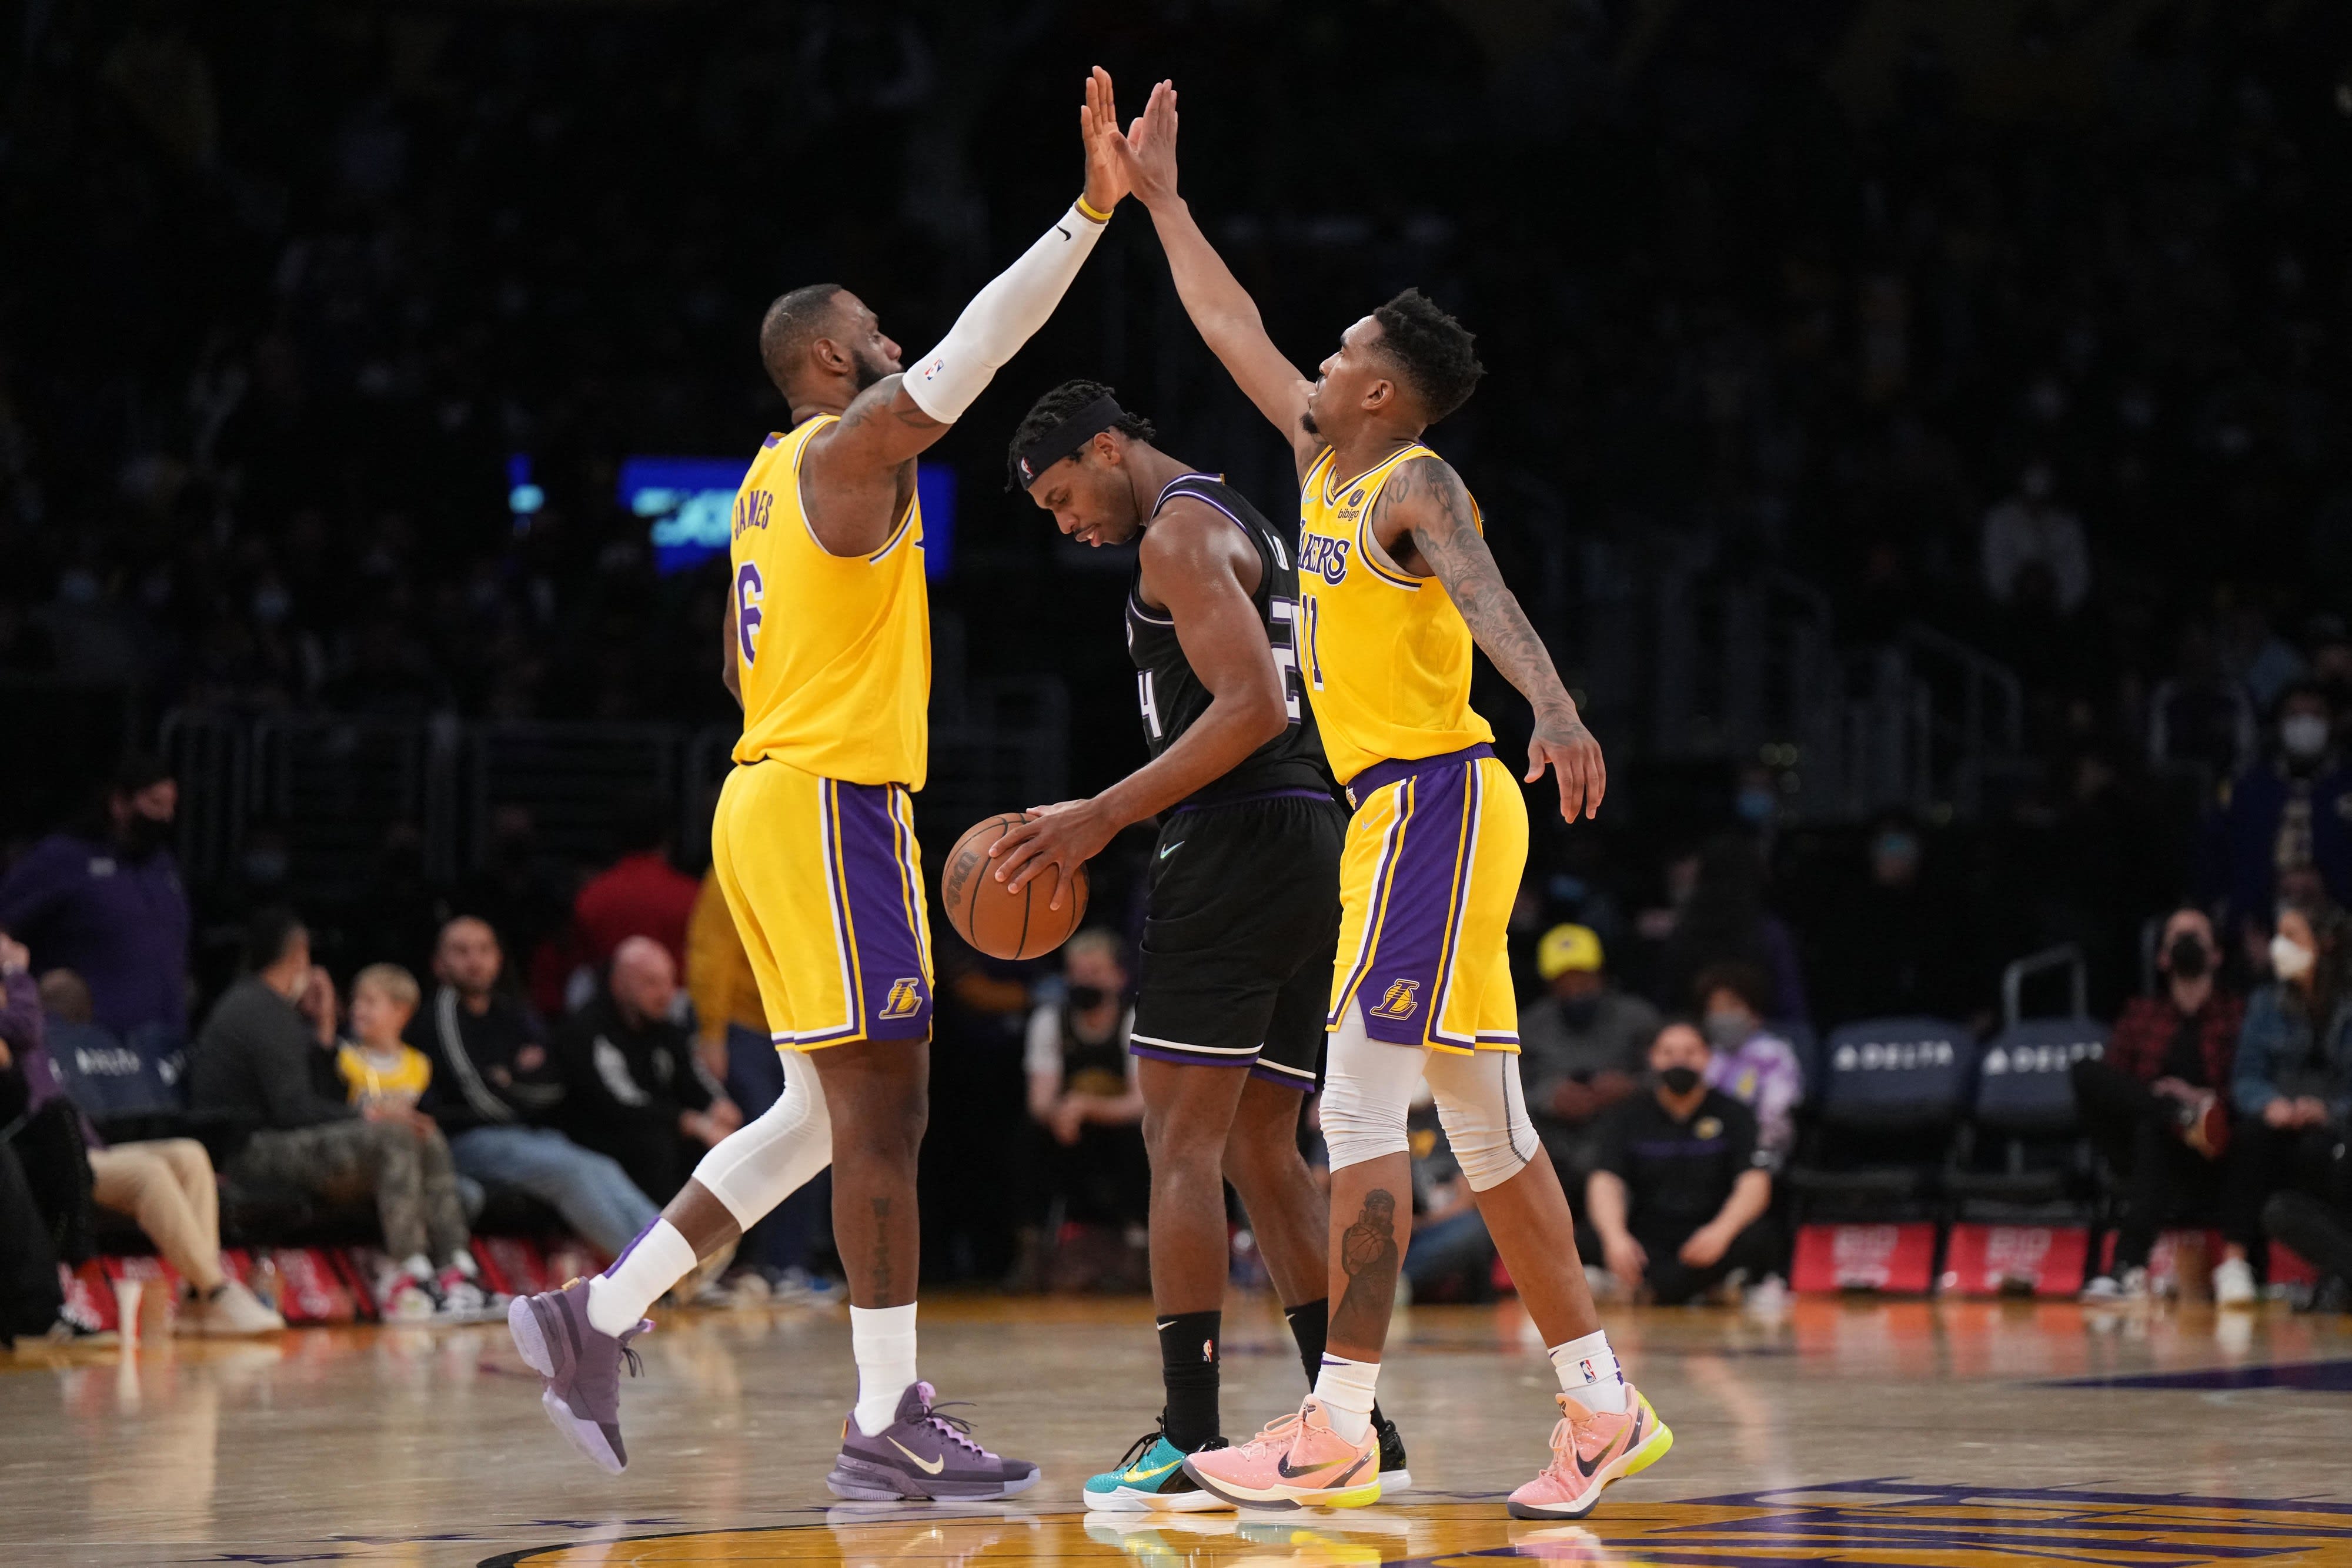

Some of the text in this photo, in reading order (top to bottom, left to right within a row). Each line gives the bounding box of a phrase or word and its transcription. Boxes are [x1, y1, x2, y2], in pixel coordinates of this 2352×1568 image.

[734, 490, 773, 541] JAMES
[1338, 508, 1359, 521] bibigo
[737, 560, 764, 670] 6
[1302, 592, 1325, 691] 11
